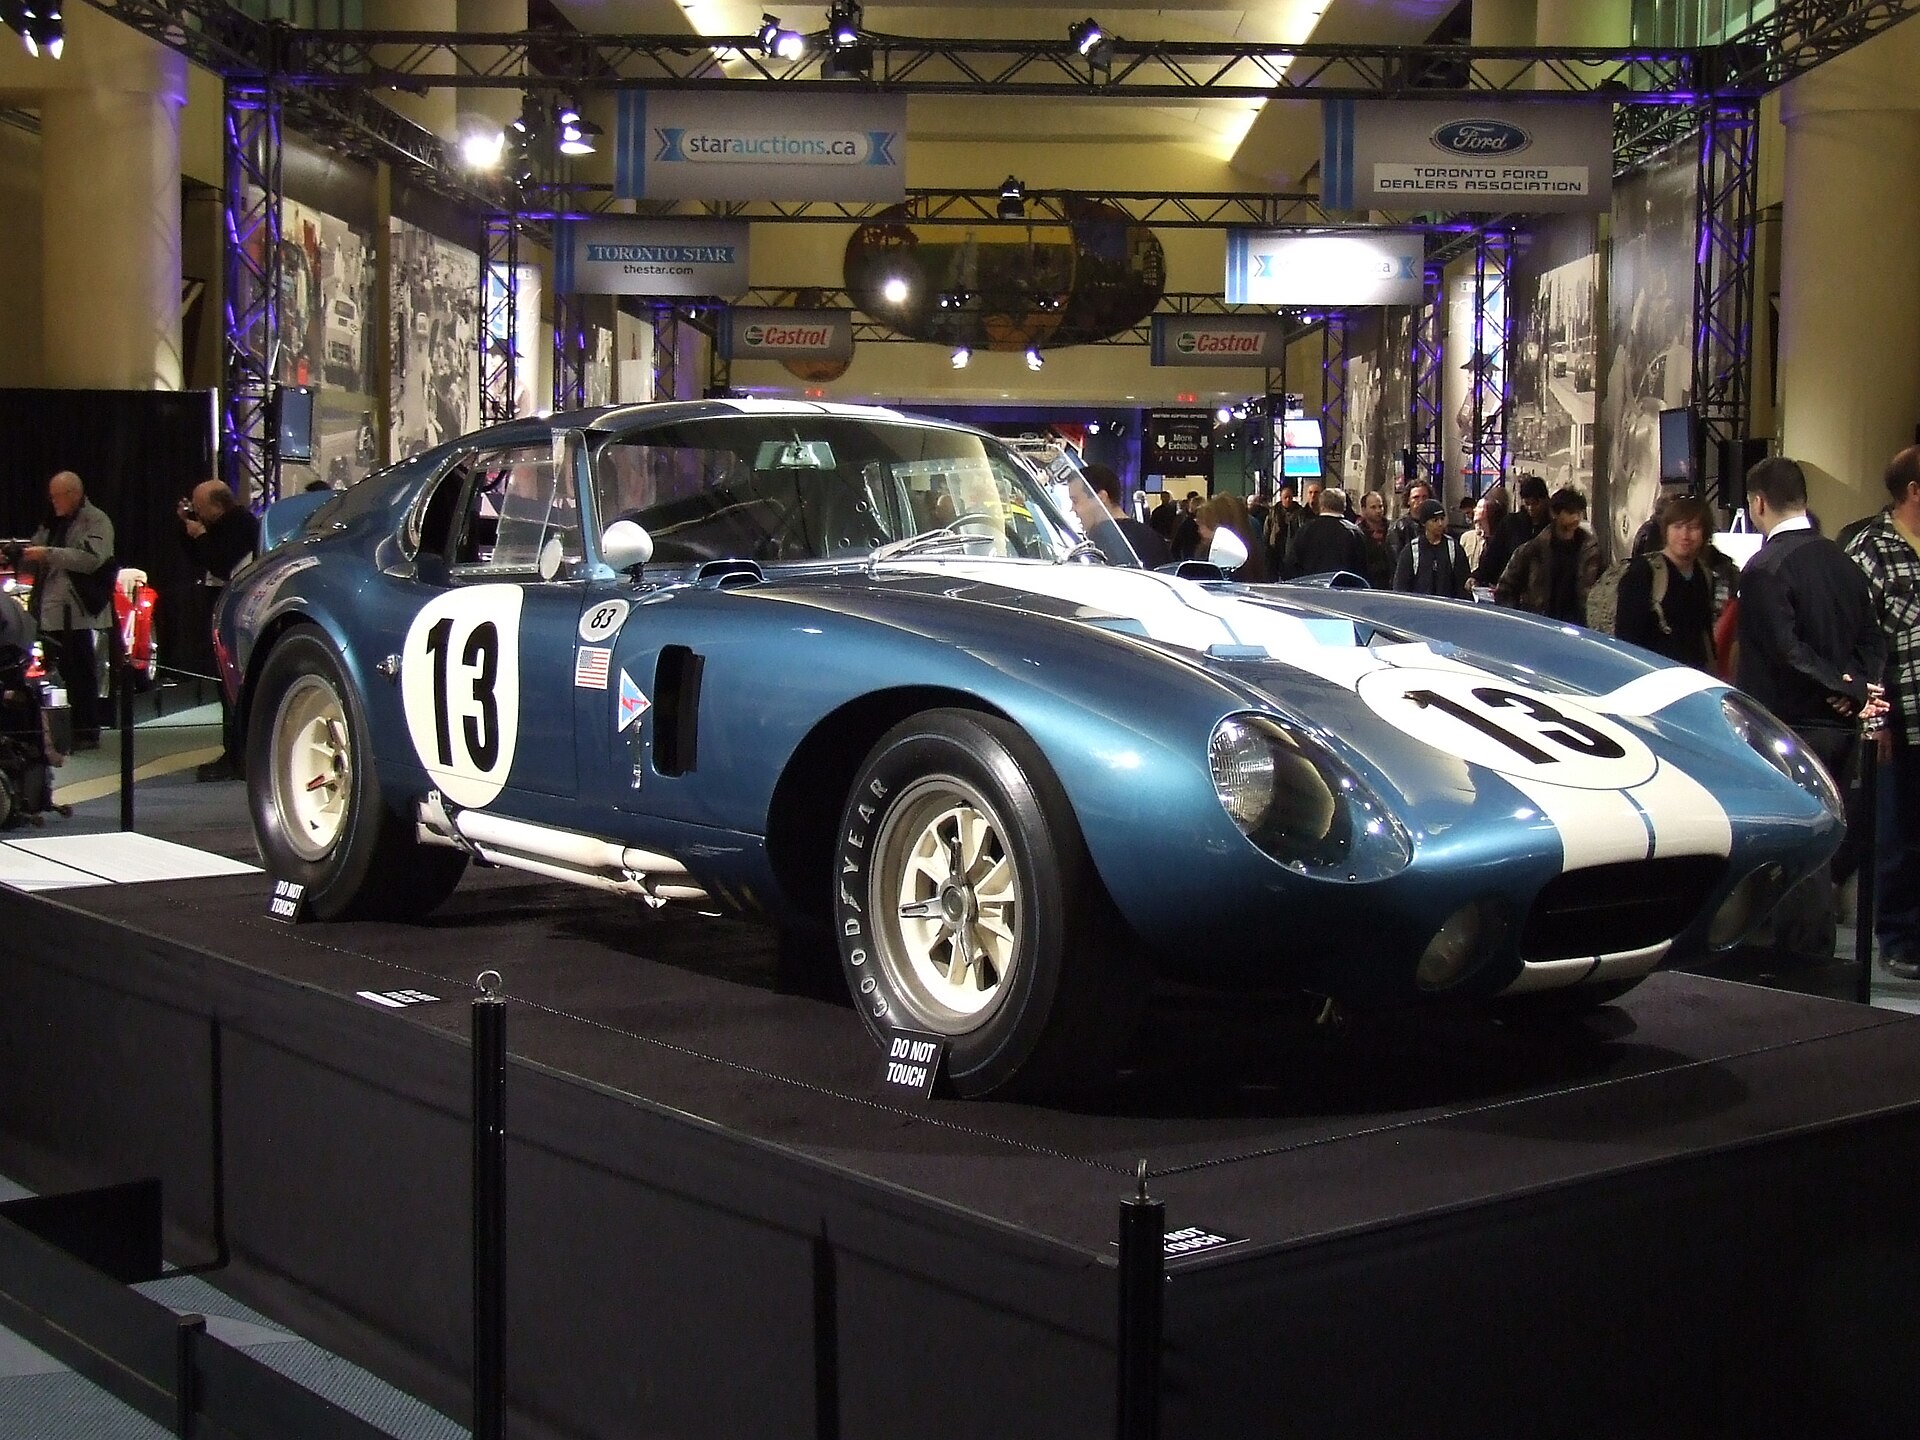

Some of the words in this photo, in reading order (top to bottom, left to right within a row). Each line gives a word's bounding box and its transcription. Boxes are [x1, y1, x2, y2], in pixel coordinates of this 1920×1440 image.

[689, 135, 857, 156] starauctions.ca
[1453, 125, 1509, 150] Ford
[1413, 167, 1496, 179] TORONTO
[1502, 168, 1549, 179] FORD
[1379, 179, 1458, 190] DEALERS
[1465, 180, 1582, 191] ASSOCIATION
[594, 246, 678, 261] TORONTO
[682, 247, 728, 262] STAR
[623, 264, 694, 275] thestar.com
[764, 326, 828, 345] Castrol
[1197, 333, 1260, 352] Castrol
[1173, 433, 1193, 442] More
[590, 608, 618, 629] 83
[425, 617, 500, 773] 13
[1401, 687, 1626, 765] 13
[275, 880, 290, 896] DO
[286, 883, 305, 899] NOT
[840, 777, 889, 1019] GOODYEAR
[271, 897, 297, 917] TOUCH
[890, 1037, 910, 1060] DO
[909, 1041, 937, 1064] NOT
[886, 1062, 928, 1088] TOUCH
